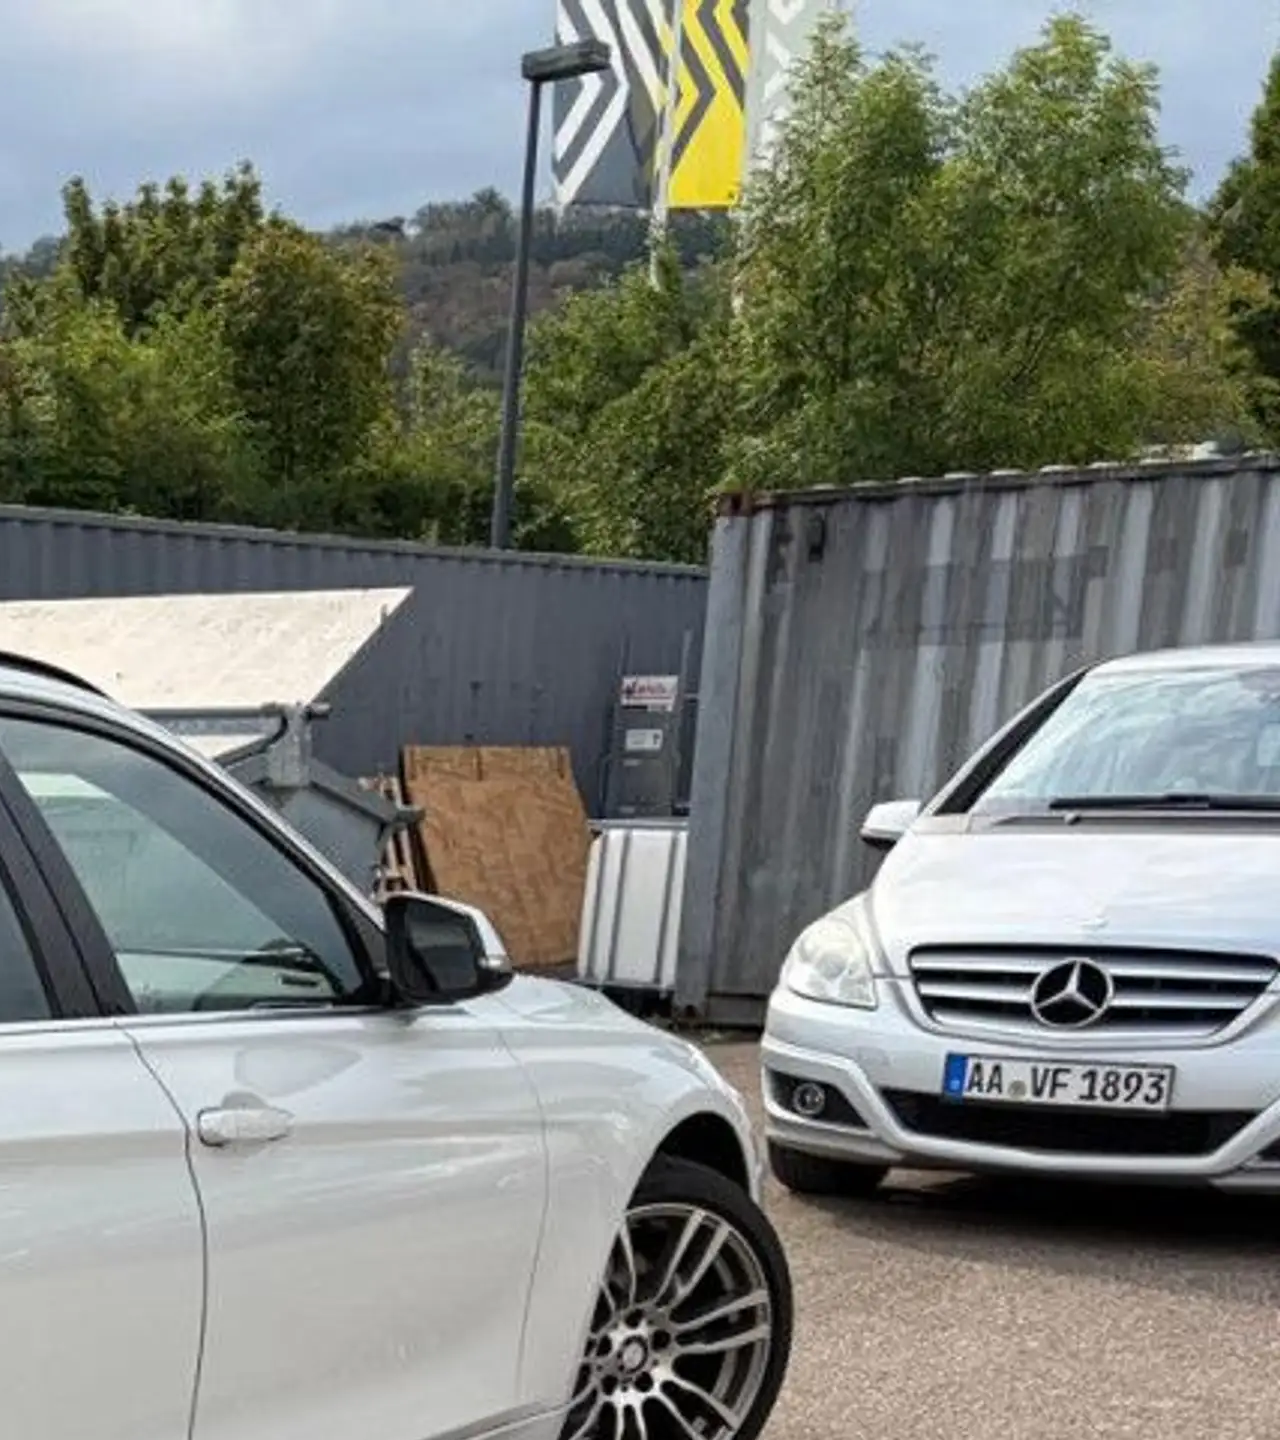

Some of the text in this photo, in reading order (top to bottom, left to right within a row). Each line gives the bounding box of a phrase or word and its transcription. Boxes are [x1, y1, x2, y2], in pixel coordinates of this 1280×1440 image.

[967, 1062, 1166, 1105] AA VF 1893
